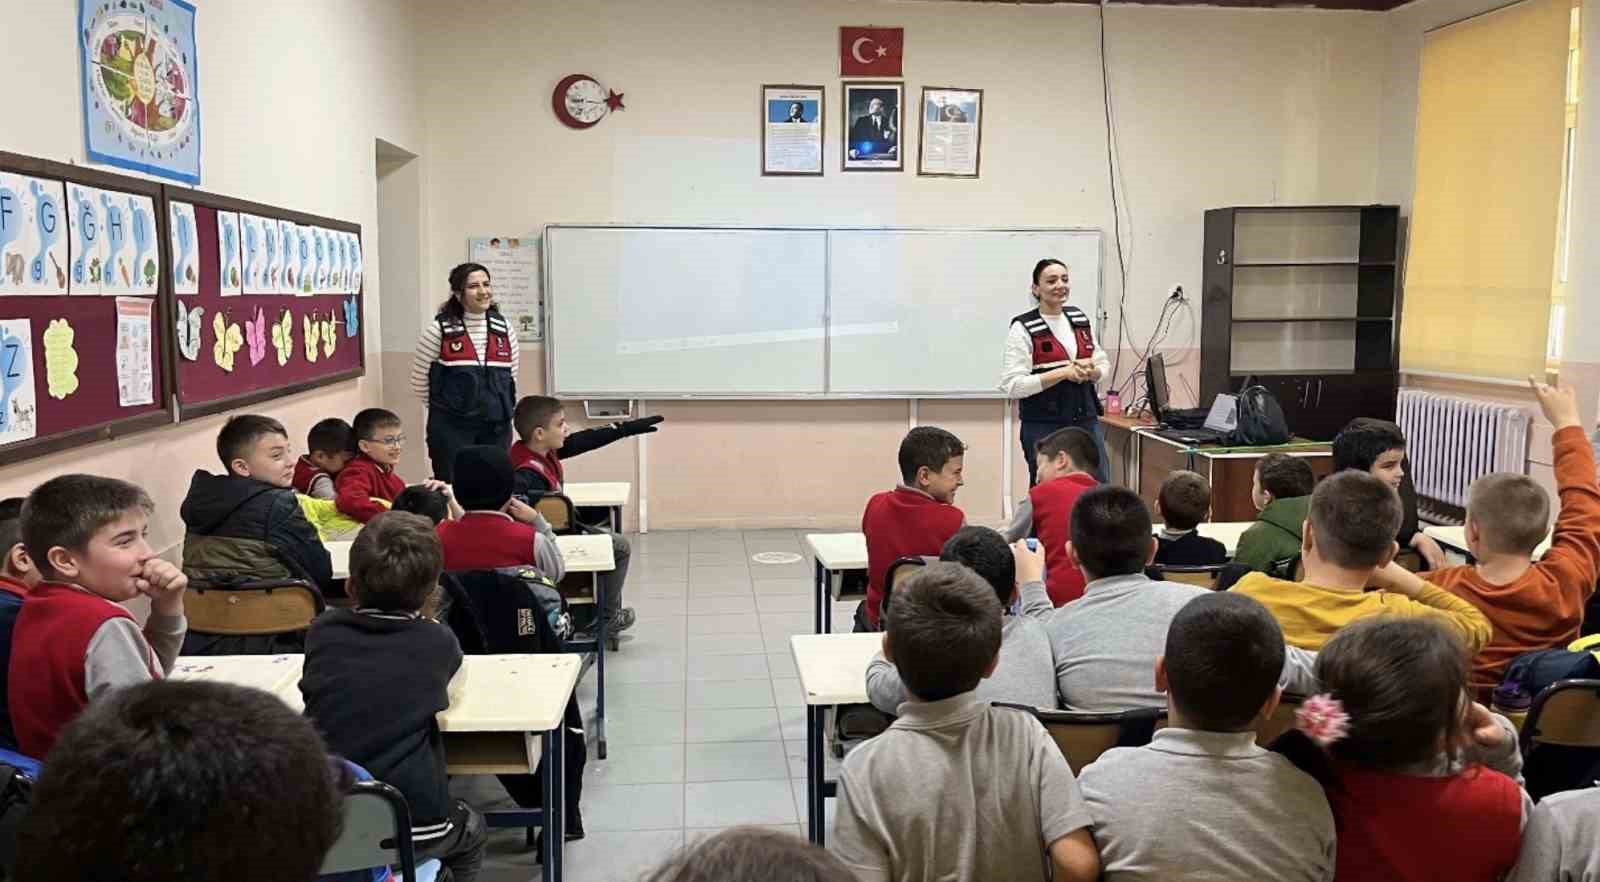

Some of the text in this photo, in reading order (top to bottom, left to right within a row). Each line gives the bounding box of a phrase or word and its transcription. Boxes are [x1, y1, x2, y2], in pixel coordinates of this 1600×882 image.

[1, 196, 13, 231] F
[41, 201, 56, 233] G
[83, 204, 96, 240] Ğ
[110, 211, 122, 240] H
[5, 344, 20, 377] Z
